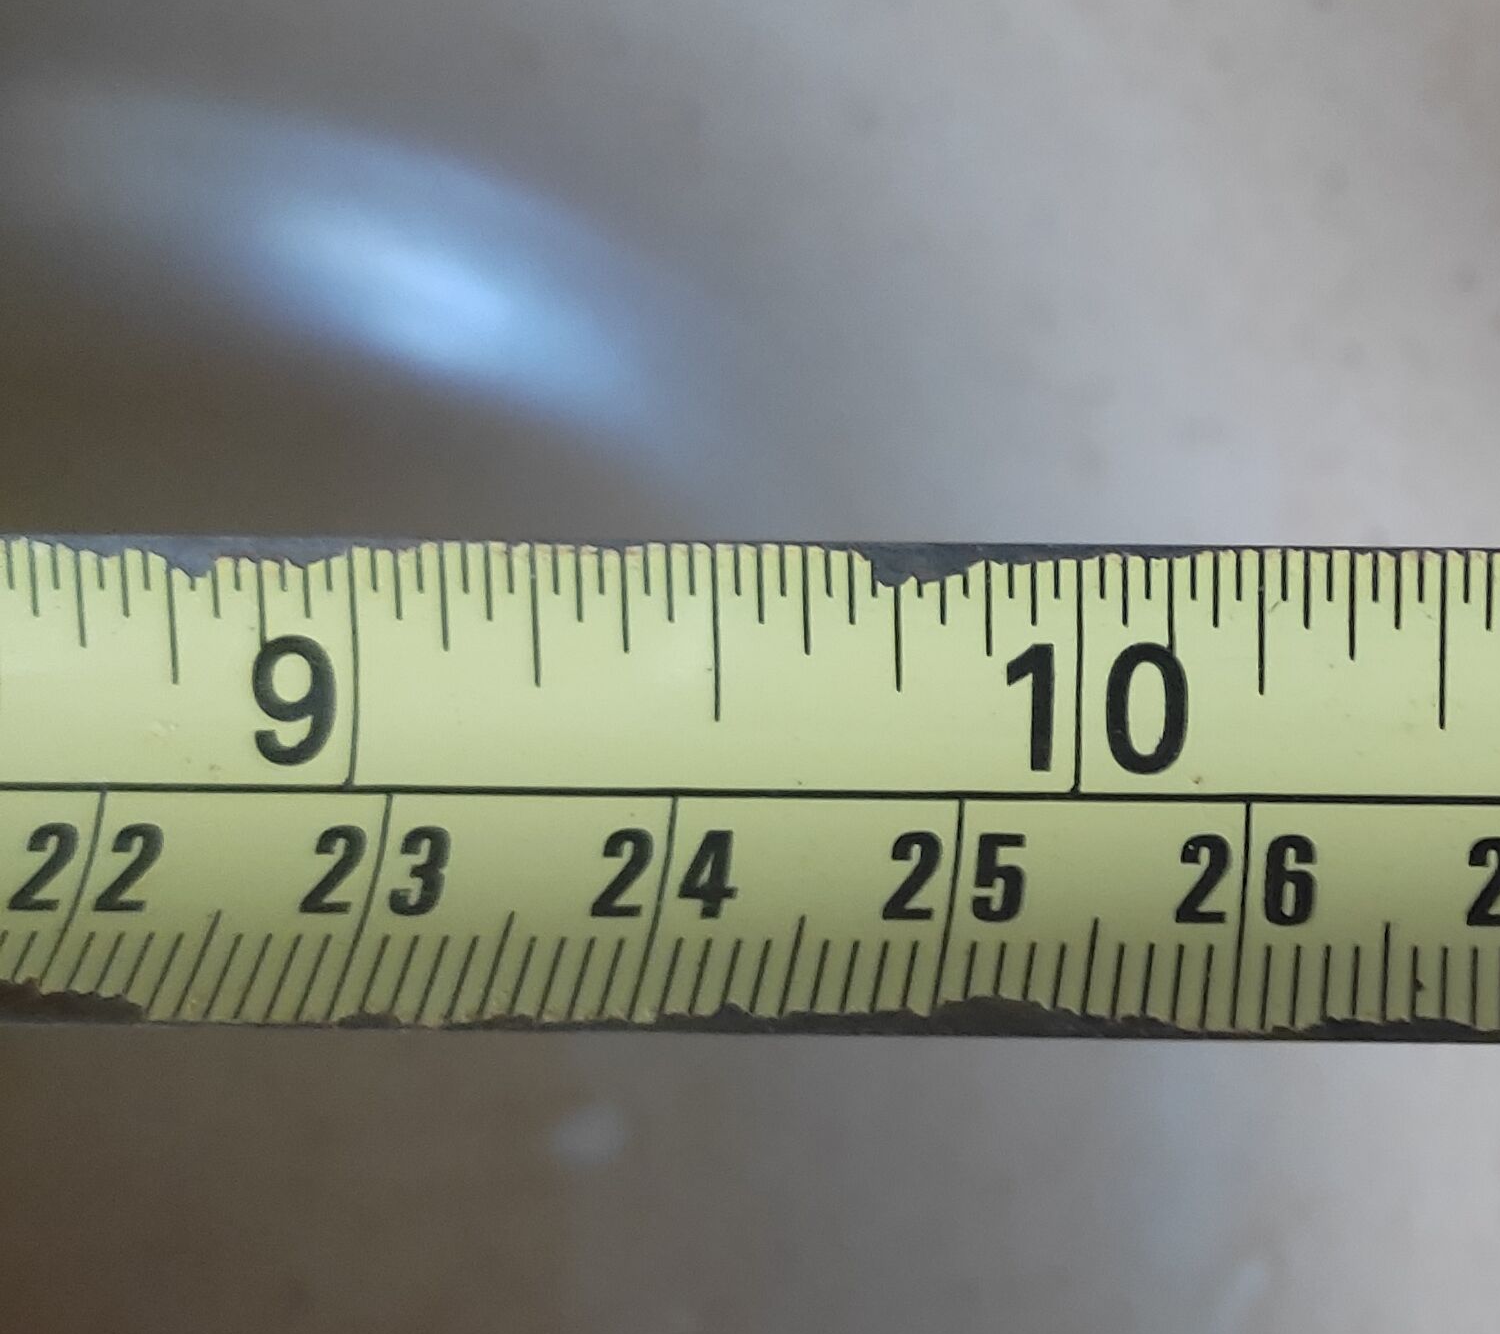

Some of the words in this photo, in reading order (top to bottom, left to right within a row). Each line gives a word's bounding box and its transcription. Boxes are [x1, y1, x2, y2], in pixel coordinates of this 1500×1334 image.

[252, 634, 338, 765] 9
[1004, 642, 1189, 775] 10
[9, 822, 165, 913] 22
[299, 825, 451, 917] 23
[591, 828, 739, 920] 24
[881, 831, 1027, 922] 25
[1173, 833, 1318, 925] 26
